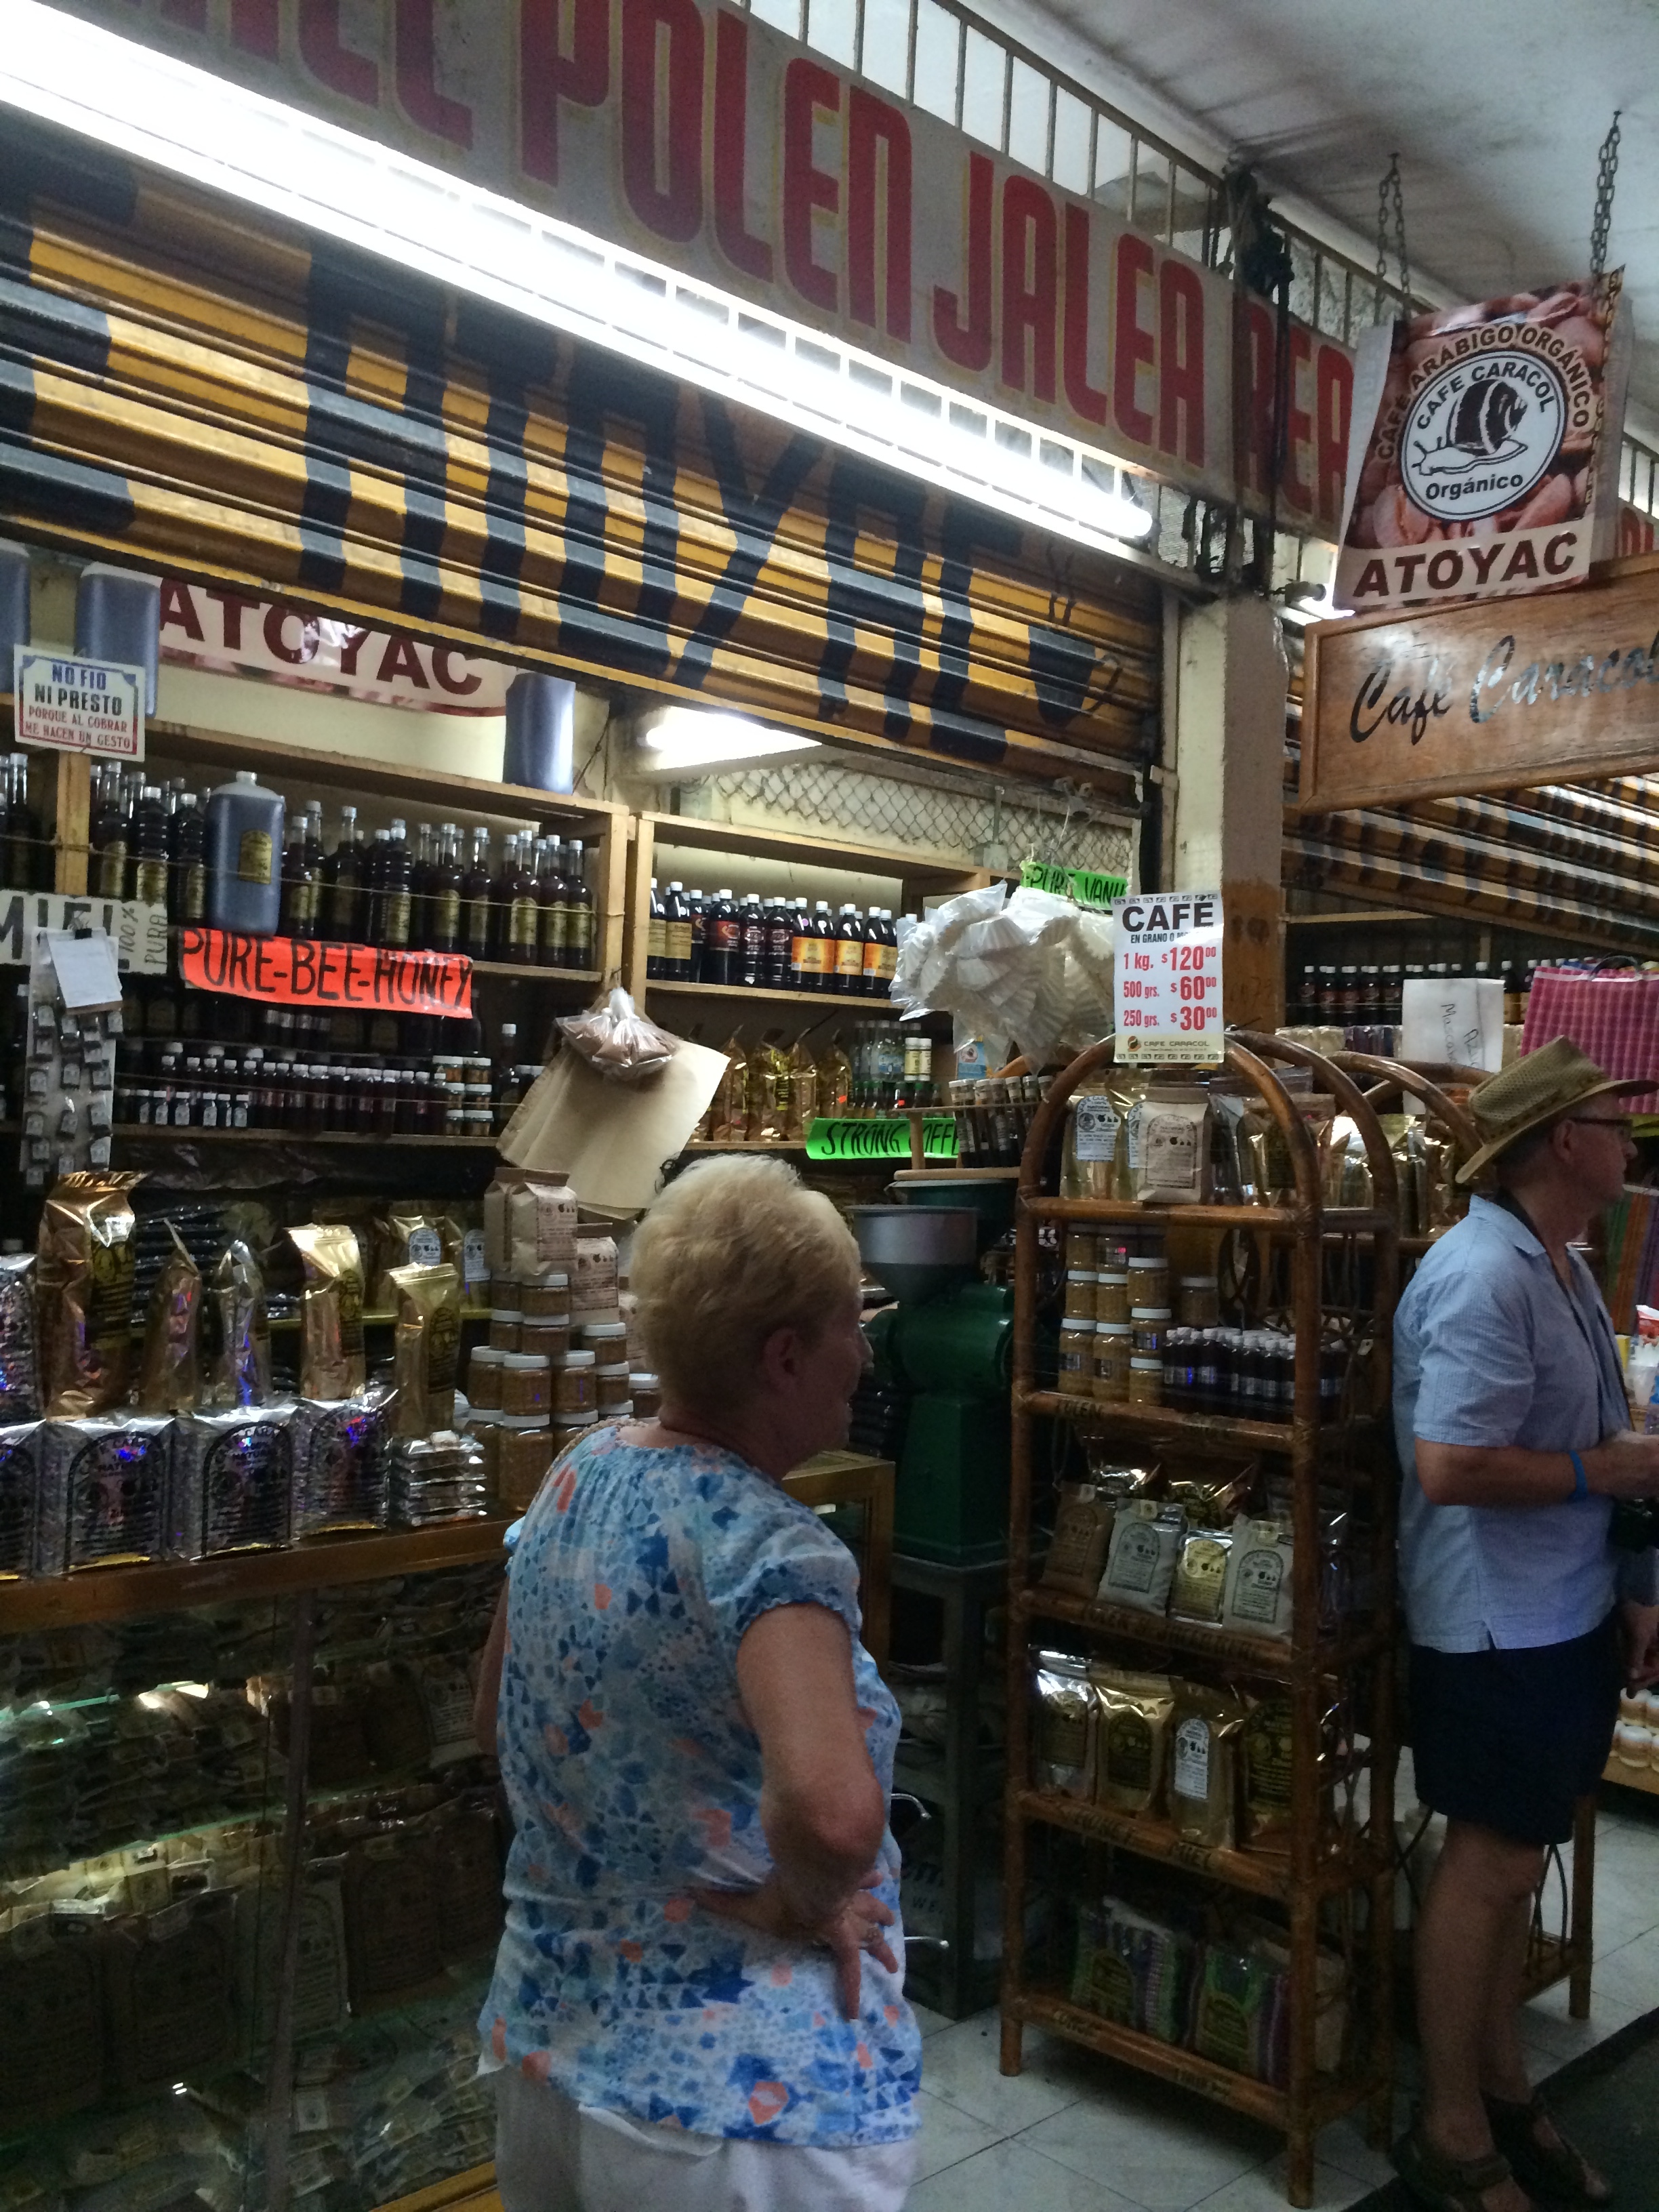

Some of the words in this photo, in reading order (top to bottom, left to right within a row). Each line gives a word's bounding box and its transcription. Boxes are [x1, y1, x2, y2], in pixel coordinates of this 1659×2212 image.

[520, 0, 912, 344] POLEN
[933, 150, 1205, 468] JALEA
[1235, 298, 1354, 523] REA
[1521, 326, 1591, 428] ORGÁNICO
[1416, 375, 1465, 430] CAFE
[1471, 361, 1555, 413] CARACOL
[1425, 473, 1524, 500] Orgánico
[1355, 531, 1579, 598] ATOYAC
[160, 577, 483, 696] ATOYAC
[52, 663, 75, 685] NO
[80, 669, 106, 691] FIO
[35, 683, 52, 704] NI
[58, 687, 123, 716] PRESTO
[25, 721, 39, 735] ME
[43, 724, 75, 741] HACEN
[97, 733, 131, 750] GESTO
[28, 705, 67, 723] PORQUE
[72, 714, 83, 726] AL
[87, 716, 127, 733] COBRAR
[118, 906, 139, 953] 100%
[1130, 934, 1141, 944] EN
[1142, 933, 1168, 943] GRANO
[1124, 981, 1142, 998] 500
[1144, 986, 1160, 999] grs.
[1124, 1010, 1142, 1027] 250
[1144, 1015, 1160, 1028] grs.
[821, 1122, 907, 1157] STRONG
